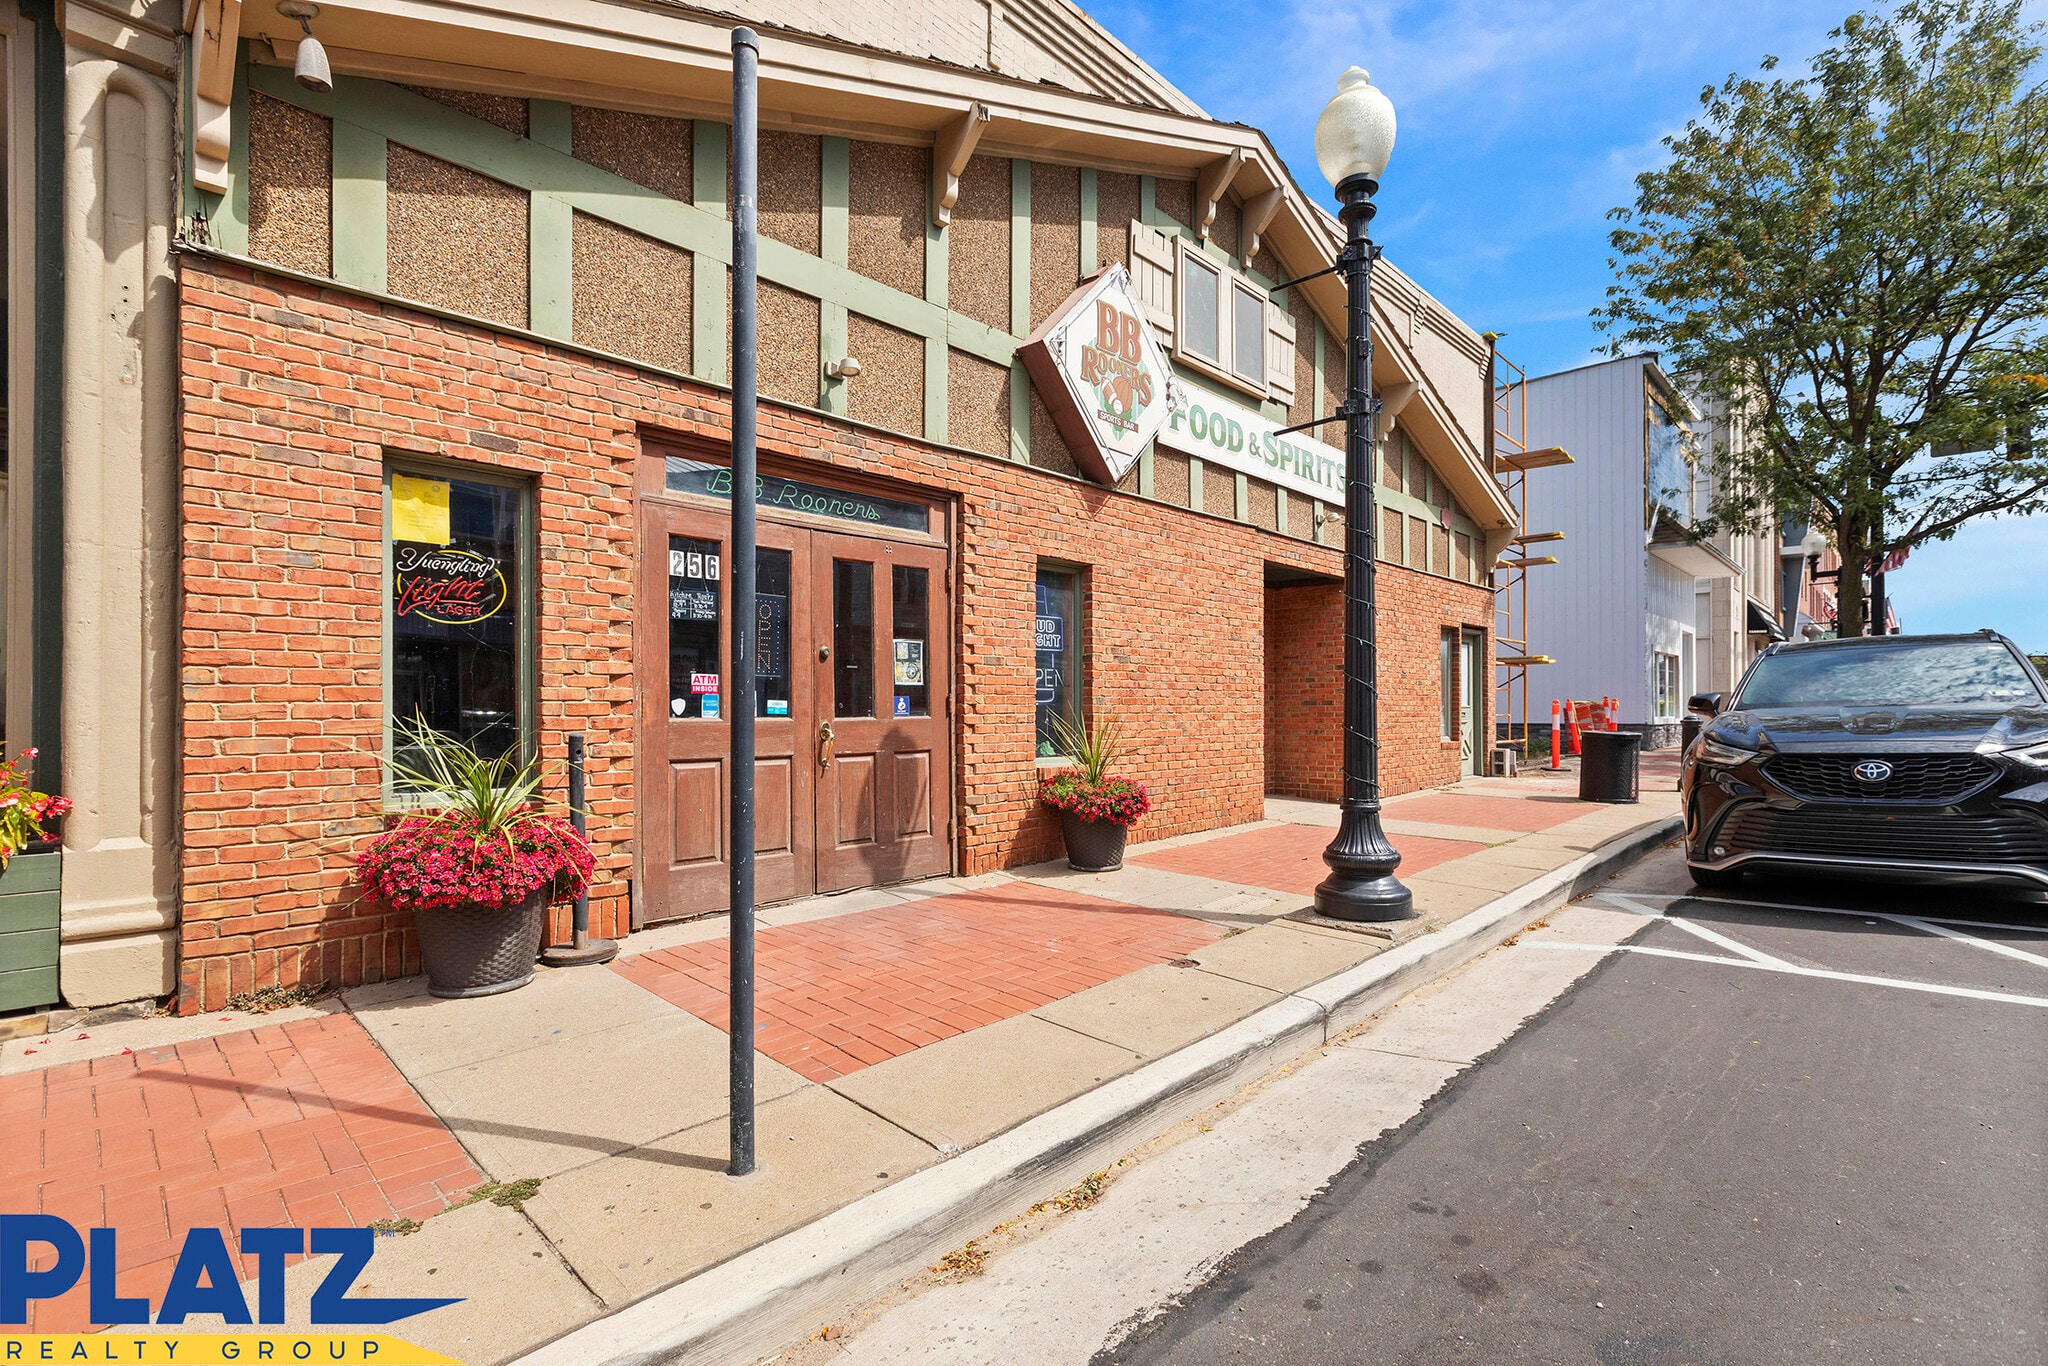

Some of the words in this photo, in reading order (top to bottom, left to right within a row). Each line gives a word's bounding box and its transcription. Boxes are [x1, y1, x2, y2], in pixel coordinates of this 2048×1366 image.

[1096, 299, 1142, 365] BB
[1080, 345, 1152, 407] ROONERS
[1099, 411, 1122, 426] SPORTS
[1123, 419, 1135, 431] BAR
[1169, 397, 1244, 453] FOOD
[1249, 431, 1262, 458] &
[1263, 431, 1346, 494] SPIRITS
[769, 484, 881, 520] Rooners
[396, 547, 494, 578] Yuengling
[673, 552, 717, 579] 256
[397, 575, 485, 616] Light
[436, 605, 481, 616] LAGER
[757, 603, 773, 670] OPEN
[1036, 619, 1056, 633] UD
[693, 675, 717, 685] ATM
